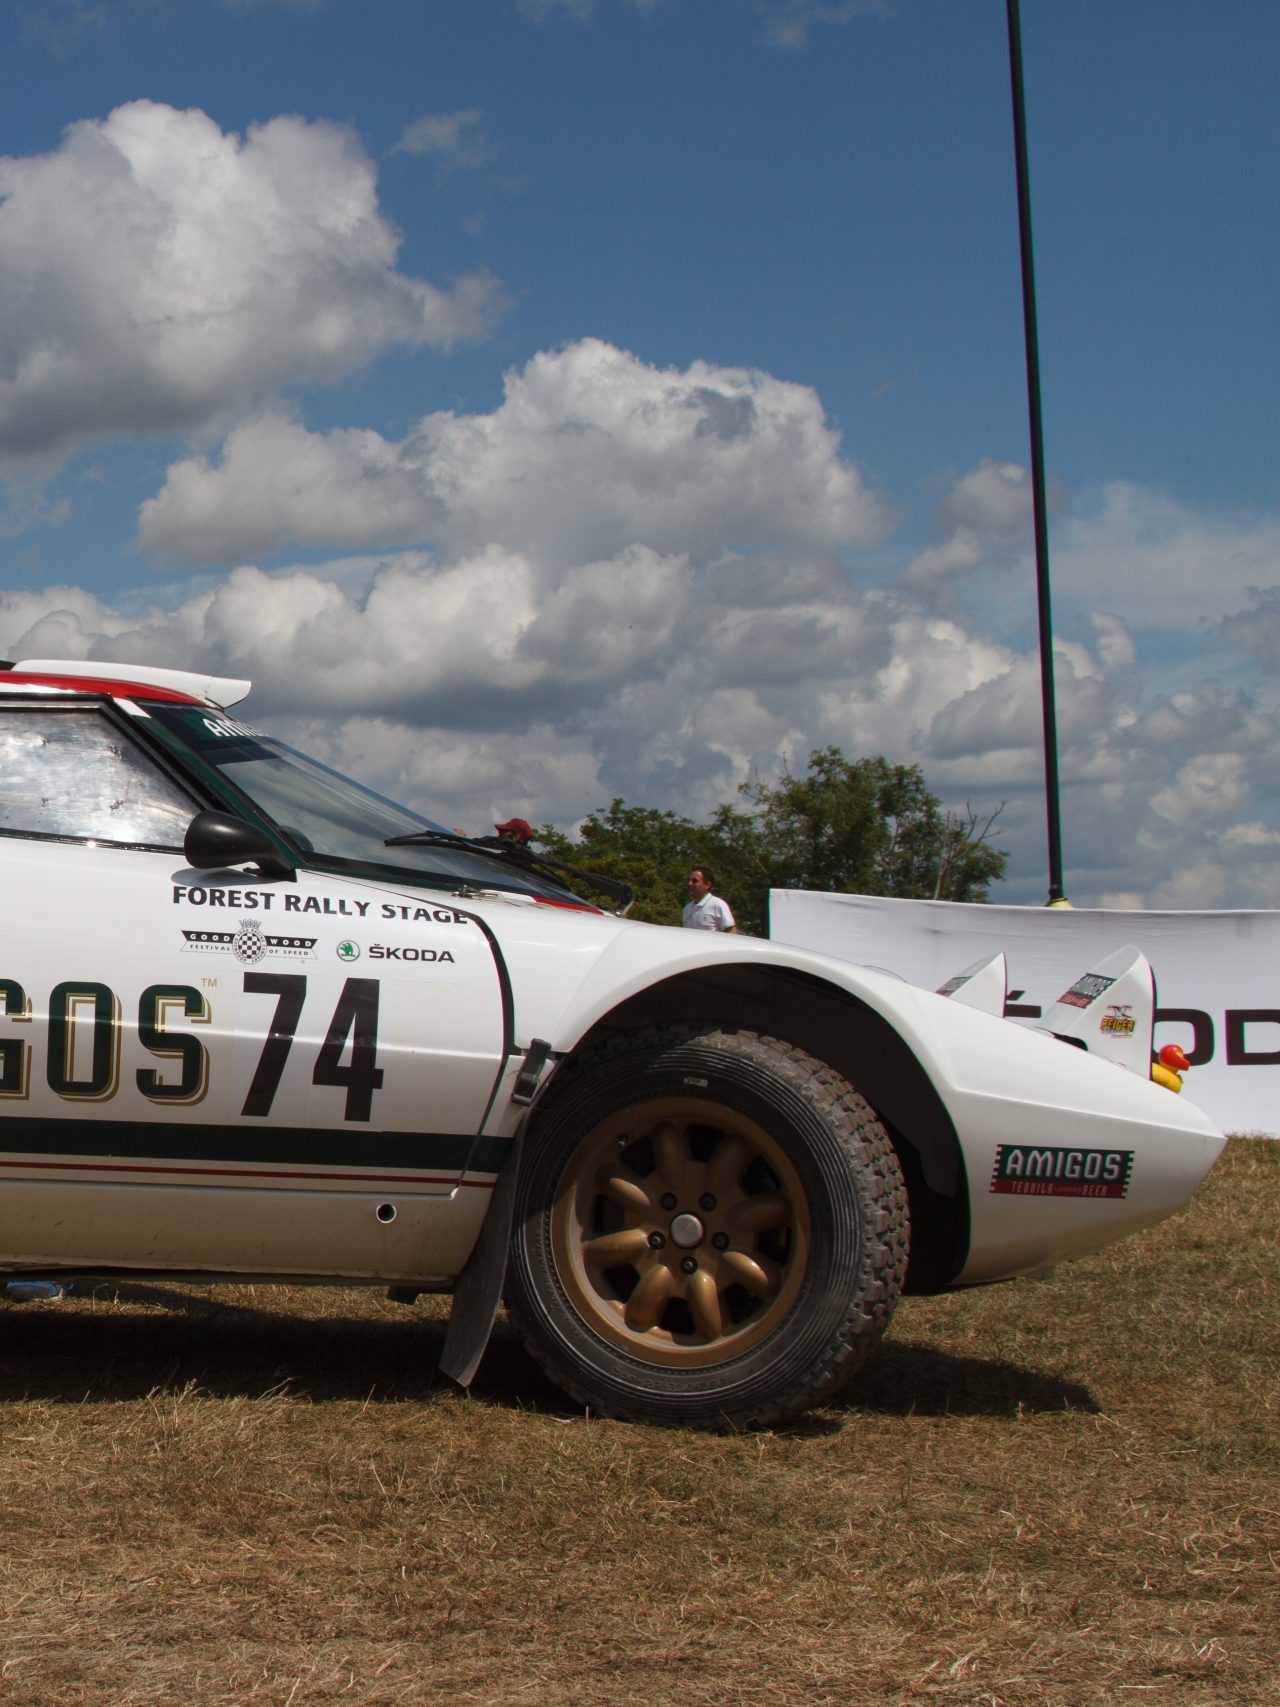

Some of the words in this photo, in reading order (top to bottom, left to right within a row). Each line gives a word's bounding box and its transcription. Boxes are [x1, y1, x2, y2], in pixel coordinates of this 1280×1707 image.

[173, 886, 275, 910] FOREST
[285, 894, 370, 917] RALLY
[381, 904, 468, 924] STAGE
[368, 943, 455, 963] ŠKODA
[240, 971, 385, 1123] 74
[1006, 1149, 1122, 1179] AMIGOS
